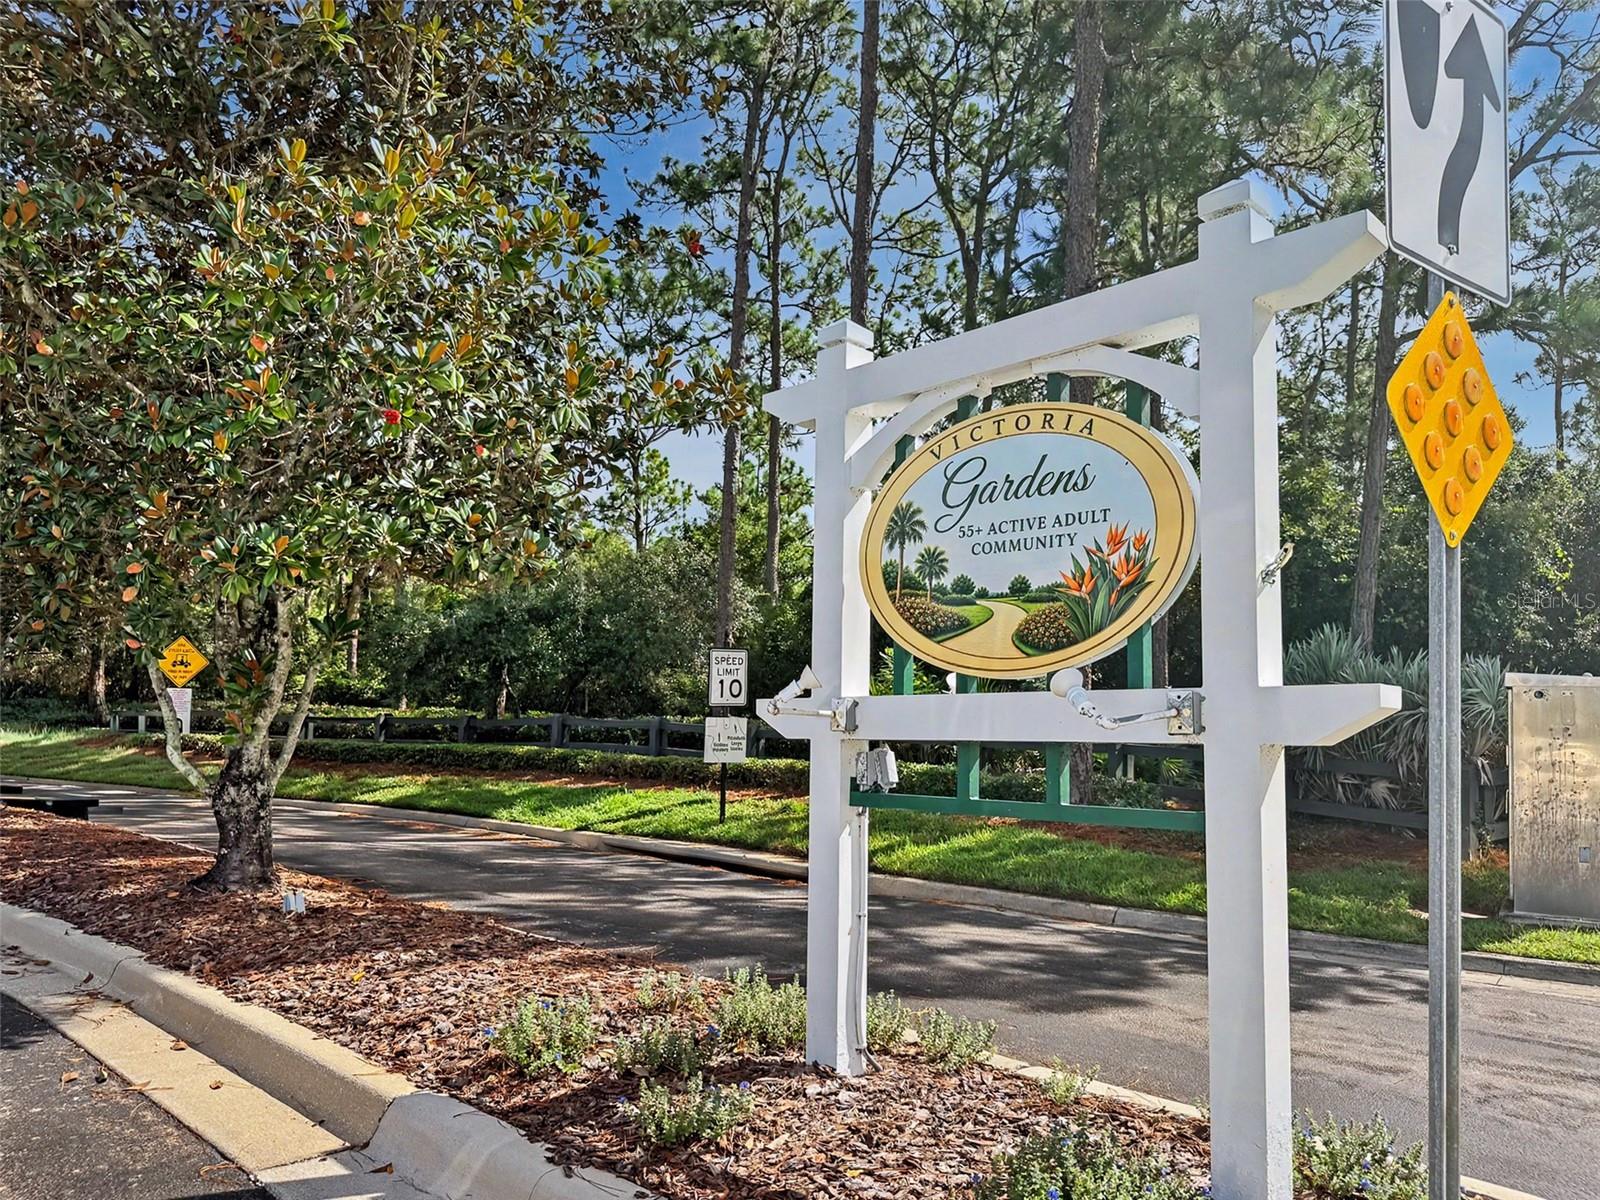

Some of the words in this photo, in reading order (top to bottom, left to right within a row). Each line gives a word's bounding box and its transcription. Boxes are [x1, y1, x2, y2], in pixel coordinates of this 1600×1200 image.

[929, 413, 1095, 461] VICTORIA
[934, 454, 1096, 533] Gardens
[958, 525, 983, 539] 55+
[987, 516, 1047, 536] ACTIVE
[1052, 508, 1111, 528] ADULT
[971, 532, 1078, 556] COMMUNITY
[714, 656, 744, 666] SPEED
[717, 668, 740, 676] LIMIT
[719, 679, 742, 698] 10
